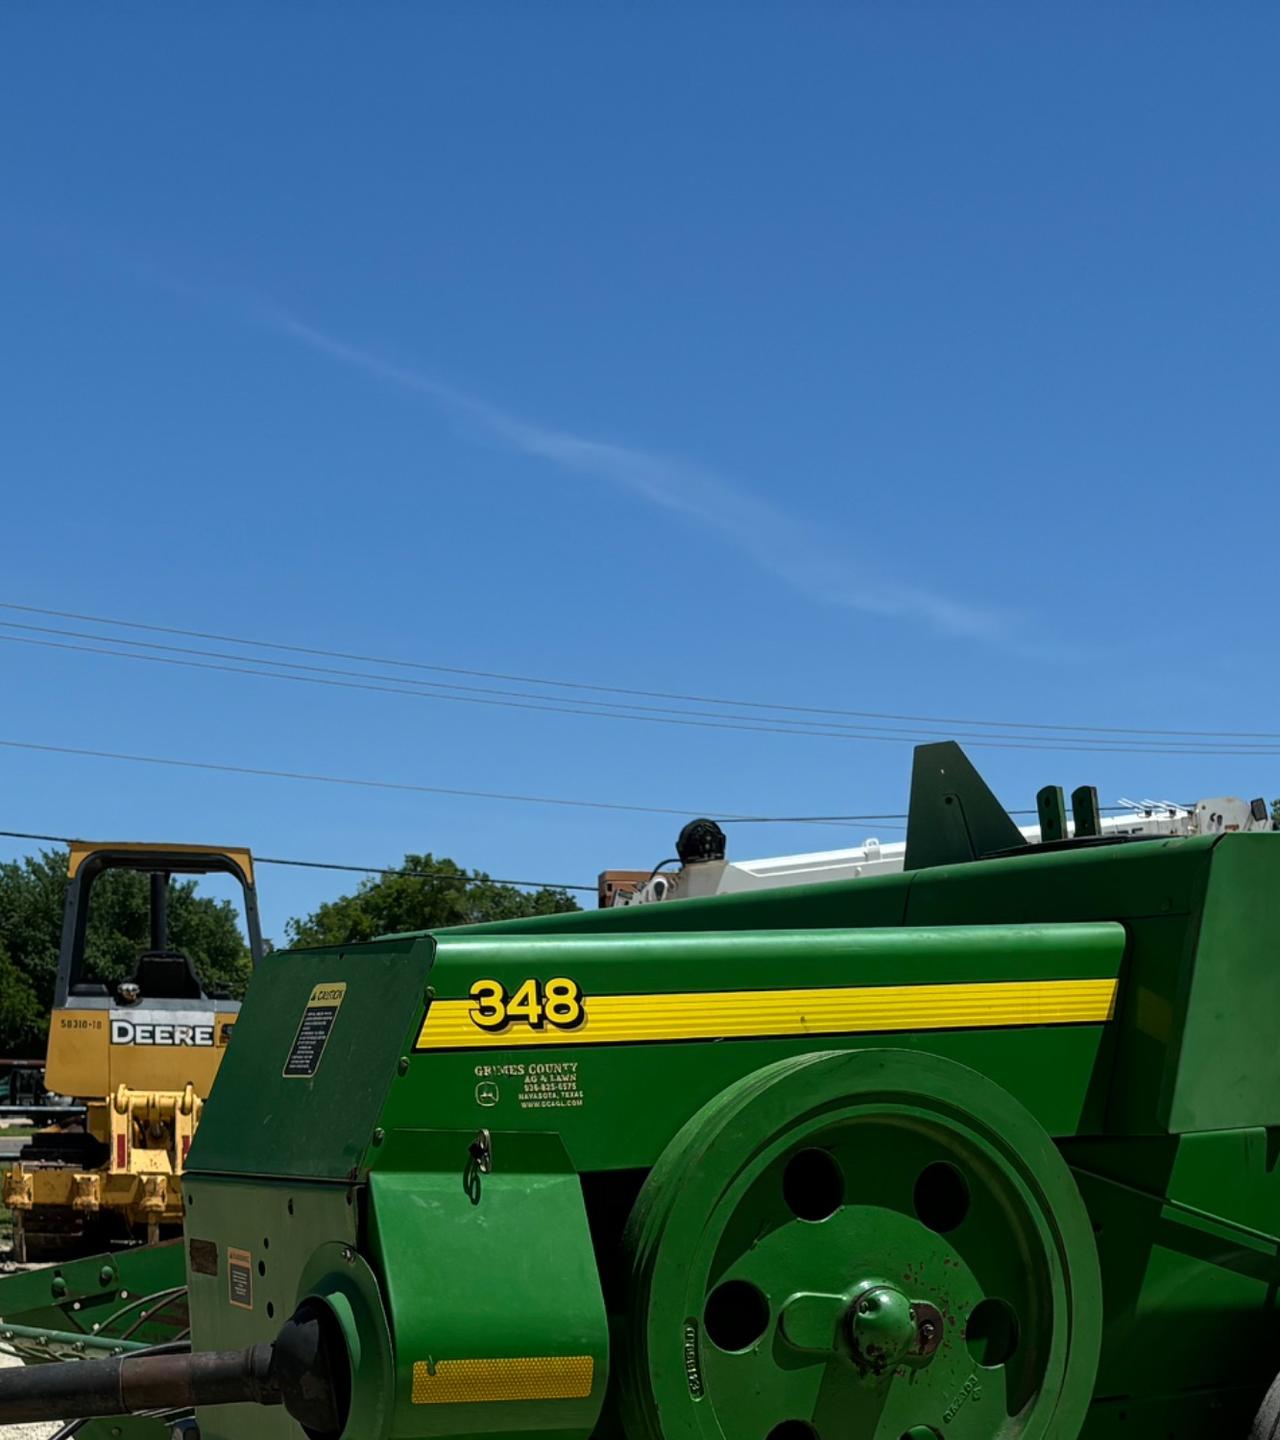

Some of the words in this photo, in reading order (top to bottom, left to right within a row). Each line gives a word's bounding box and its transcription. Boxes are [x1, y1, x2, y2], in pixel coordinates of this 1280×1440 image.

[470, 977, 582, 1031] 348
[111, 1020, 215, 1047] DEERE
[528, 1062, 578, 1074] COUNTY
[549, 1073, 577, 1083] LAWN
